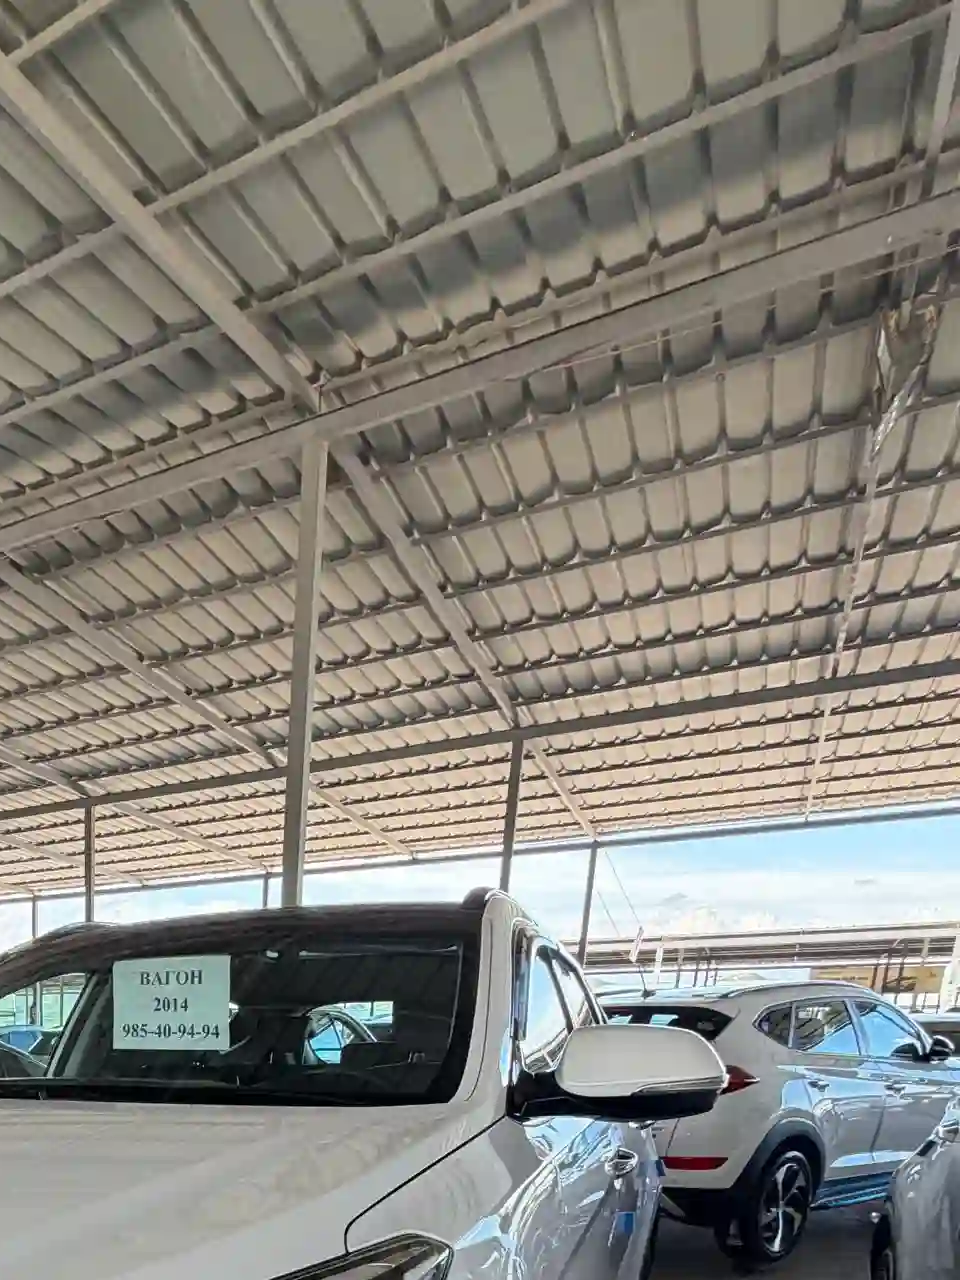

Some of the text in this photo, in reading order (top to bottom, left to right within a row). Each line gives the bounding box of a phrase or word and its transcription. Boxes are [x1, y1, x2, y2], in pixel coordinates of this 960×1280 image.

[140, 969, 203, 986] ВАГОН
[153, 997, 189, 1012] 2014
[122, 1023, 220, 1039] 985-40-94-94
